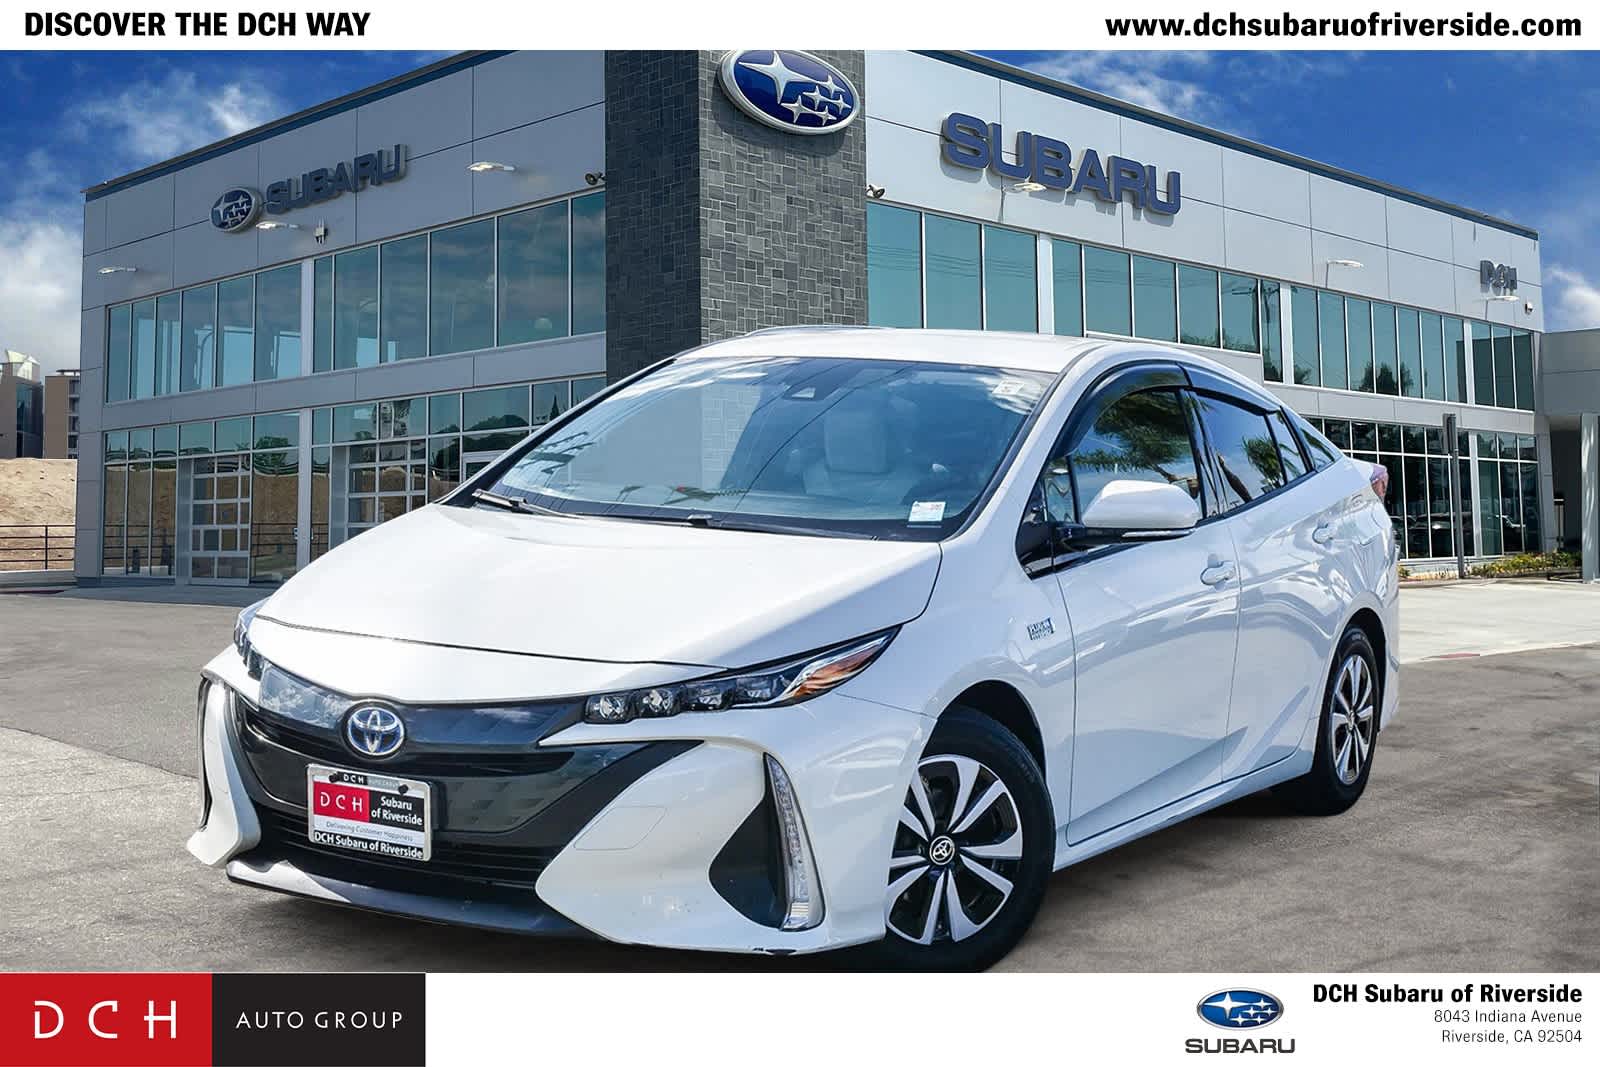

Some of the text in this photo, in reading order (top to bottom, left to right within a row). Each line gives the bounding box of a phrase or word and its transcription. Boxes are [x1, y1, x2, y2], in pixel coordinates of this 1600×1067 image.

[941, 112, 1182, 216] SUBARU
[265, 143, 406, 215] SUBARU
[343, 774, 364, 784] DCH
[320, 791, 363, 813] DCH
[380, 796, 412, 811] Subaru
[371, 808, 423, 826] of Riverside
[314, 831, 424, 859] DCH Subaru of Riverside
